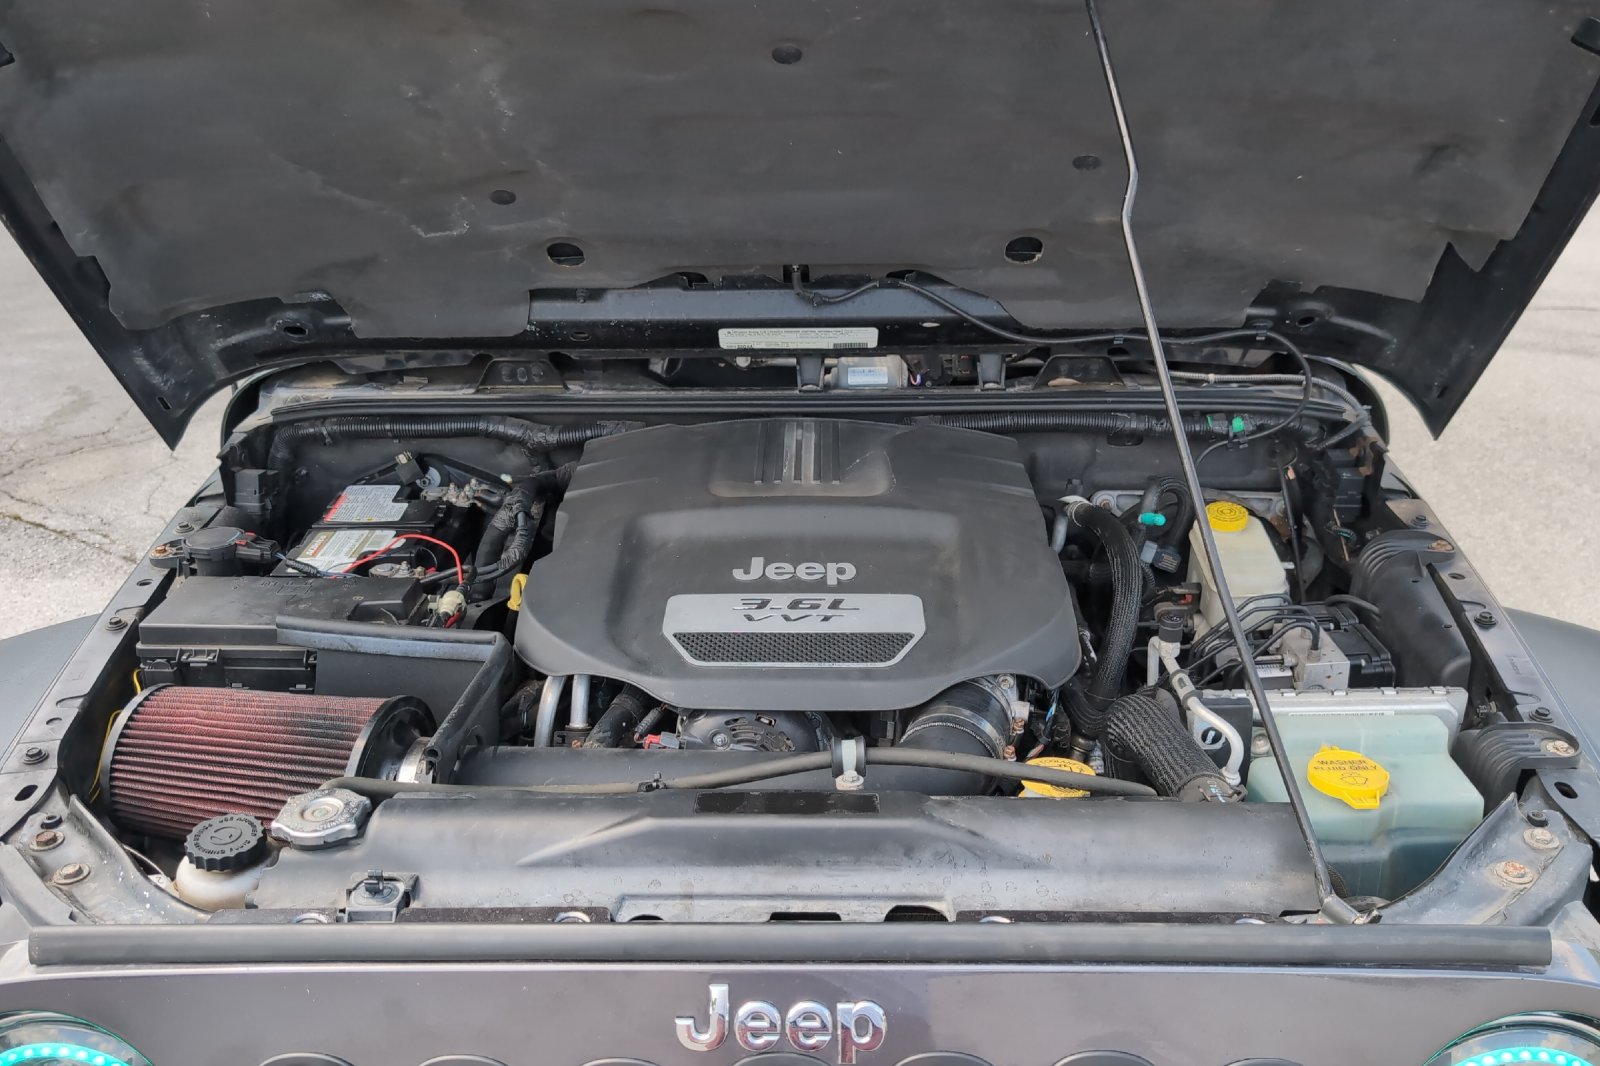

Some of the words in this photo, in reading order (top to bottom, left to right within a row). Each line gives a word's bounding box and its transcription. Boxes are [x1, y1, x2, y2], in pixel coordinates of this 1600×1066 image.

[732, 557, 857, 585] Jeep
[732, 598, 860, 610] 3.6L
[743, 614, 846, 622] VVT
[675, 983, 888, 1065] Jeep
